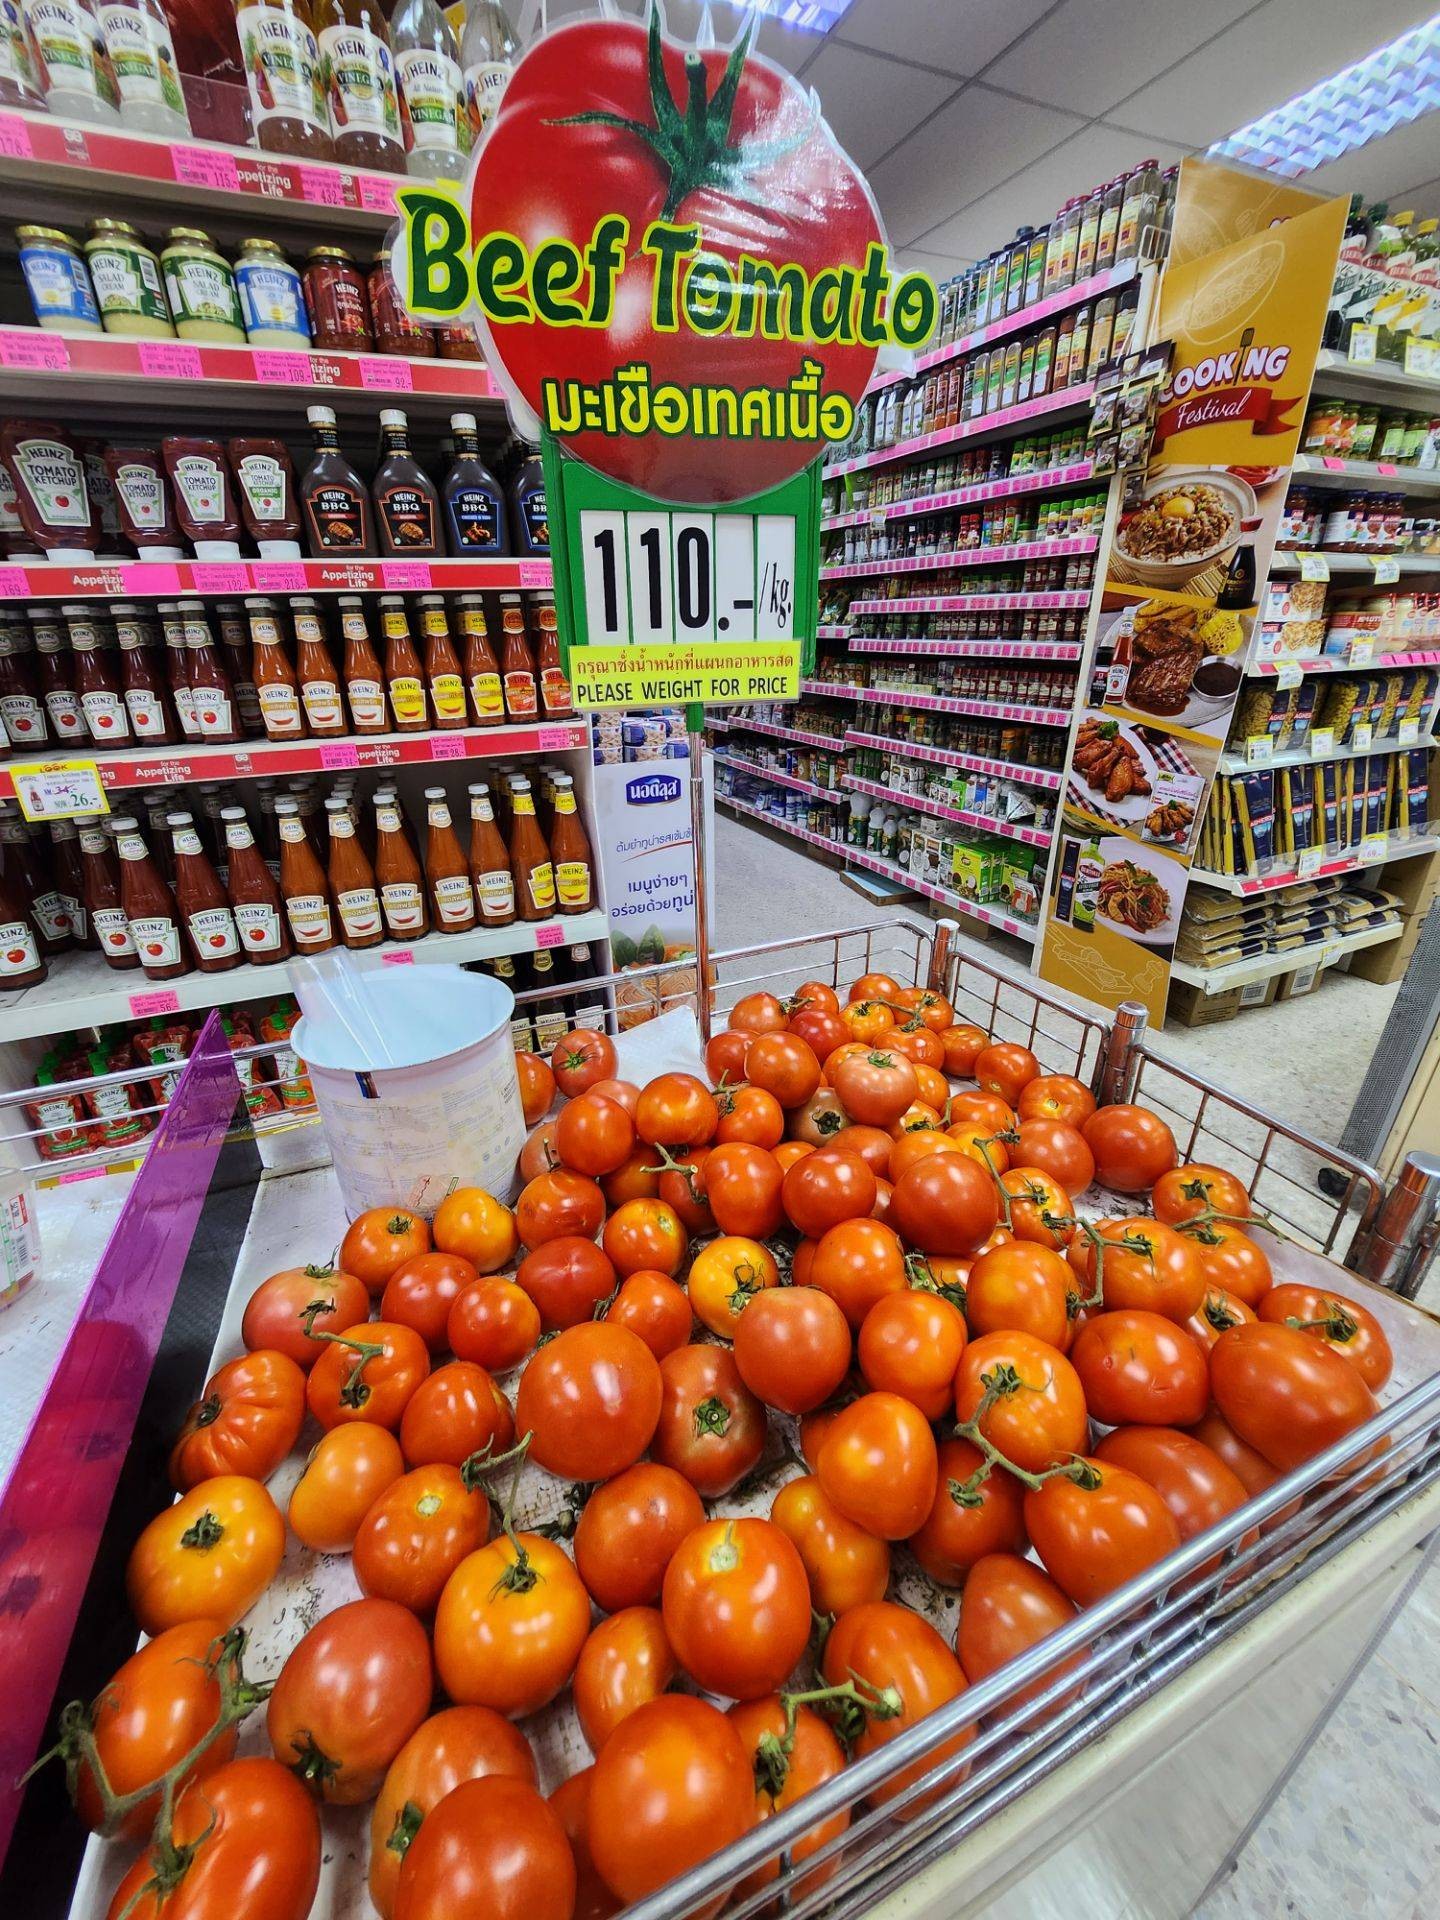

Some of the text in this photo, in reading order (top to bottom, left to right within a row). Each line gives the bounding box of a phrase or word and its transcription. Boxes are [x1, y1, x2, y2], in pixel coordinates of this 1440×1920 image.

[37, 5, 76, 26] HEINZ
[106, 16, 143, 36] HEINZ
[237, 169, 291, 190] ppetizing
[261, 182, 284, 198] Life
[93, 257, 122, 271] HEINZ
[187, 267, 219, 283] HEINZ
[402, 192, 939, 349] Beef Tomato
[256, 274, 286, 287] HEINZ
[335, 282, 359, 297] HEINZ
[313, 373, 334, 385] Life
[544, 358, 854, 440] มะเขือเทศเนื้อ
[1177, 389, 1253, 429] Festival
[29, 447, 64, 461] HEINZ
[27, 464, 77, 480] TOMATO
[184, 463, 209, 473] HEINZ
[249, 463, 272, 472] HEINZ
[34, 475, 77, 487] KETCHUP
[125, 471, 149, 480] HEINZ
[184, 476, 217, 486] TOMATO
[250, 474, 275, 482] TOMATO
[124, 483, 157, 493] TOMATO
[188, 483, 217, 492] KETCHUP
[322, 490, 346, 501] HEINZ
[394, 491, 417, 502] HEINZ
[463, 493, 485, 503] HEINZ
[321, 570, 375, 582] Appetizing
[348, 579, 367, 588] Life
[577, 648, 794, 681] กรุณาชั่งน้ำหนักที่แผนกอาหารสด
[395, 683, 418, 691] HEINZ
[438, 680, 459, 688] HEINZ
[479, 678, 499, 687] HEINZ
[266, 690, 289, 699] HEINZ
[309, 688, 331, 696] HEINZ
[352, 686, 375, 695] HEINZ
[577, 676, 788, 703] PLEASE WEIGHT FOR PRICE
[50, 696, 74, 706] HEINZ
[86, 697, 112, 706] HEINZ
[128, 695, 148, 703] HEINZ
[195, 693, 218, 701] HEINZ
[4, 701, 31, 710] HEINZ
[377, 756, 394, 765] Life
[135, 765, 191, 778] Appetizing
[164, 773, 185, 782] Life
[70, 792, 98, 807] 26.-
[562, 868, 584, 876] HEINZ
[442, 881, 465, 891] HEINZ
[486, 876, 507, 886] HEINZ
[628, 873, 688, 893] เมนูง่ายๆ
[388, 889, 412, 898] HEINZ
[292, 900, 318, 910] HEINZ
[346, 894, 370, 905] HEINZ
[611, 889, 696, 918] อร่อยด้วยทูน่
[99, 912, 126, 923] HEINZ
[197, 914, 226, 925] HEINZ
[240, 909, 267, 919] HEINZ
[136, 922, 164, 933] HEINZ
[0, 928, 23, 939] EINZ
[98, 1087, 121, 1099] HEINZ
[43, 1102, 65, 1114] HEINZ
